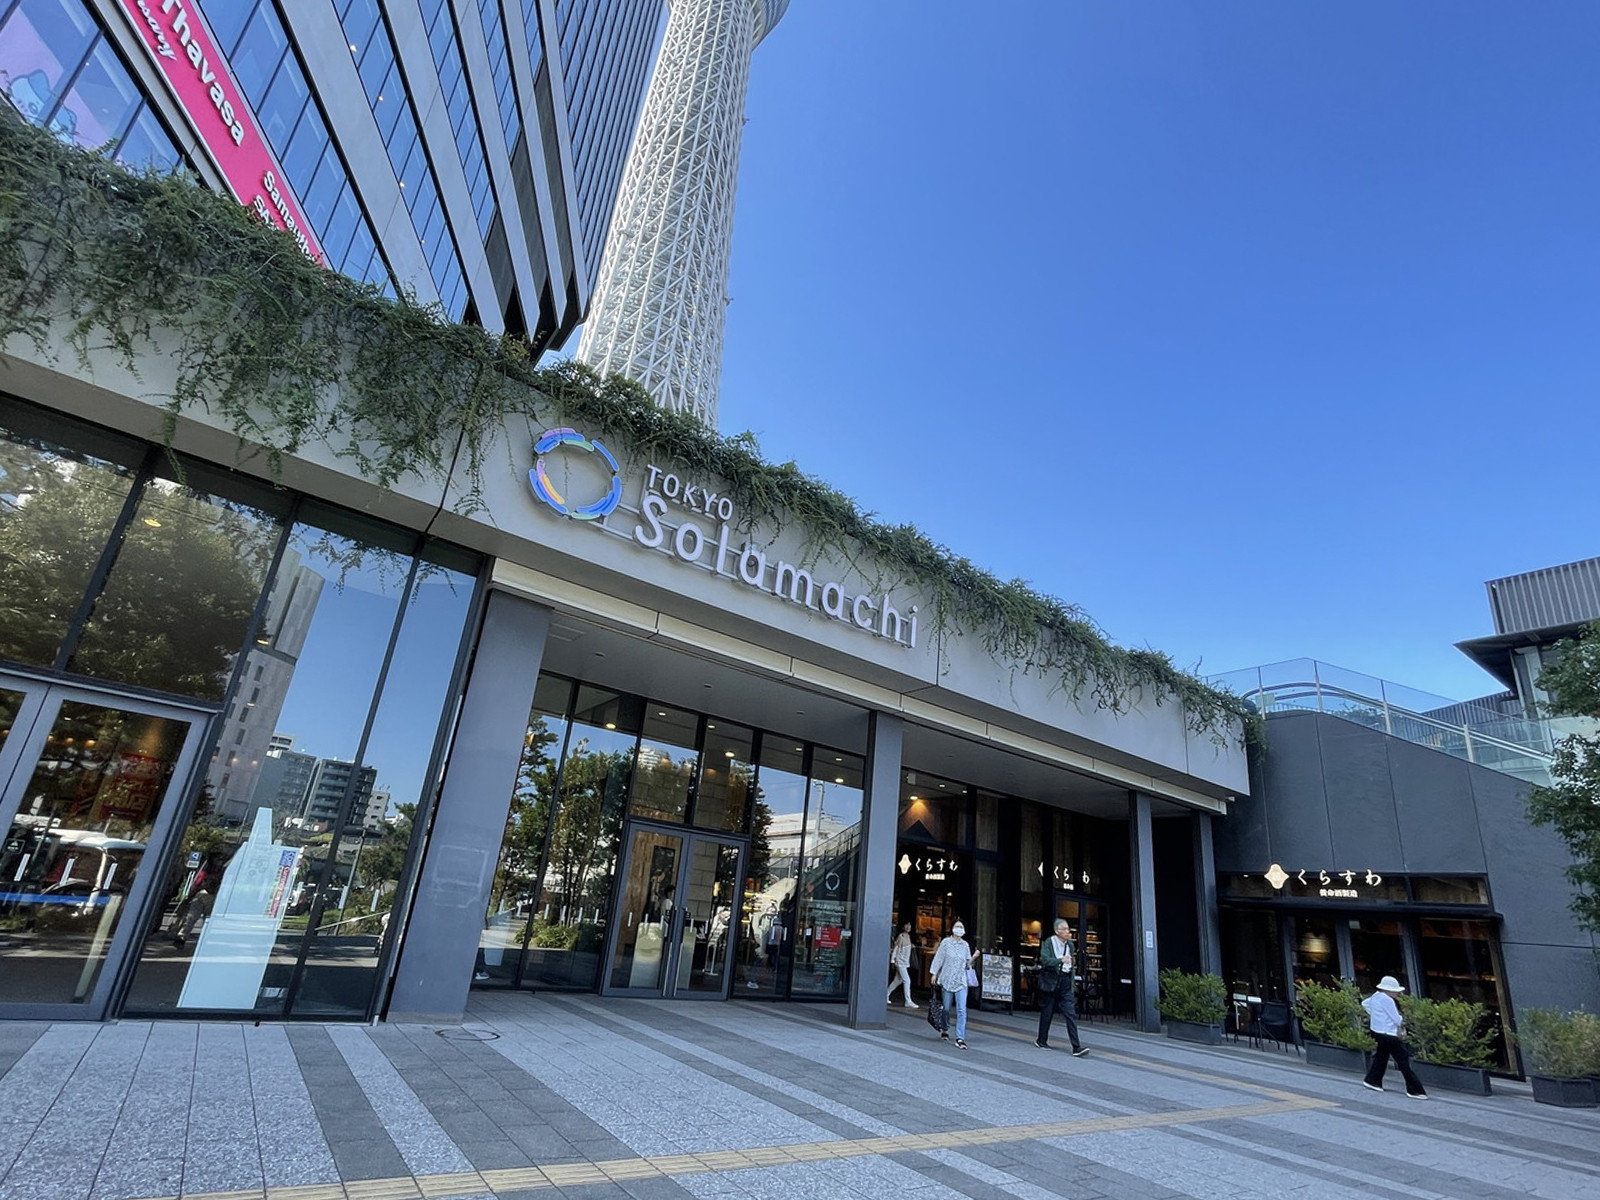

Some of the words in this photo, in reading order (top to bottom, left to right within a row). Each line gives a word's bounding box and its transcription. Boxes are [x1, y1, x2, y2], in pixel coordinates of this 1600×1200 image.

[647, 463, 734, 521] TOKYO
[635, 494, 919, 648] Solamachi
[1053, 865, 1090, 885] くらわ
[1297, 868, 1382, 887] くらすわ
